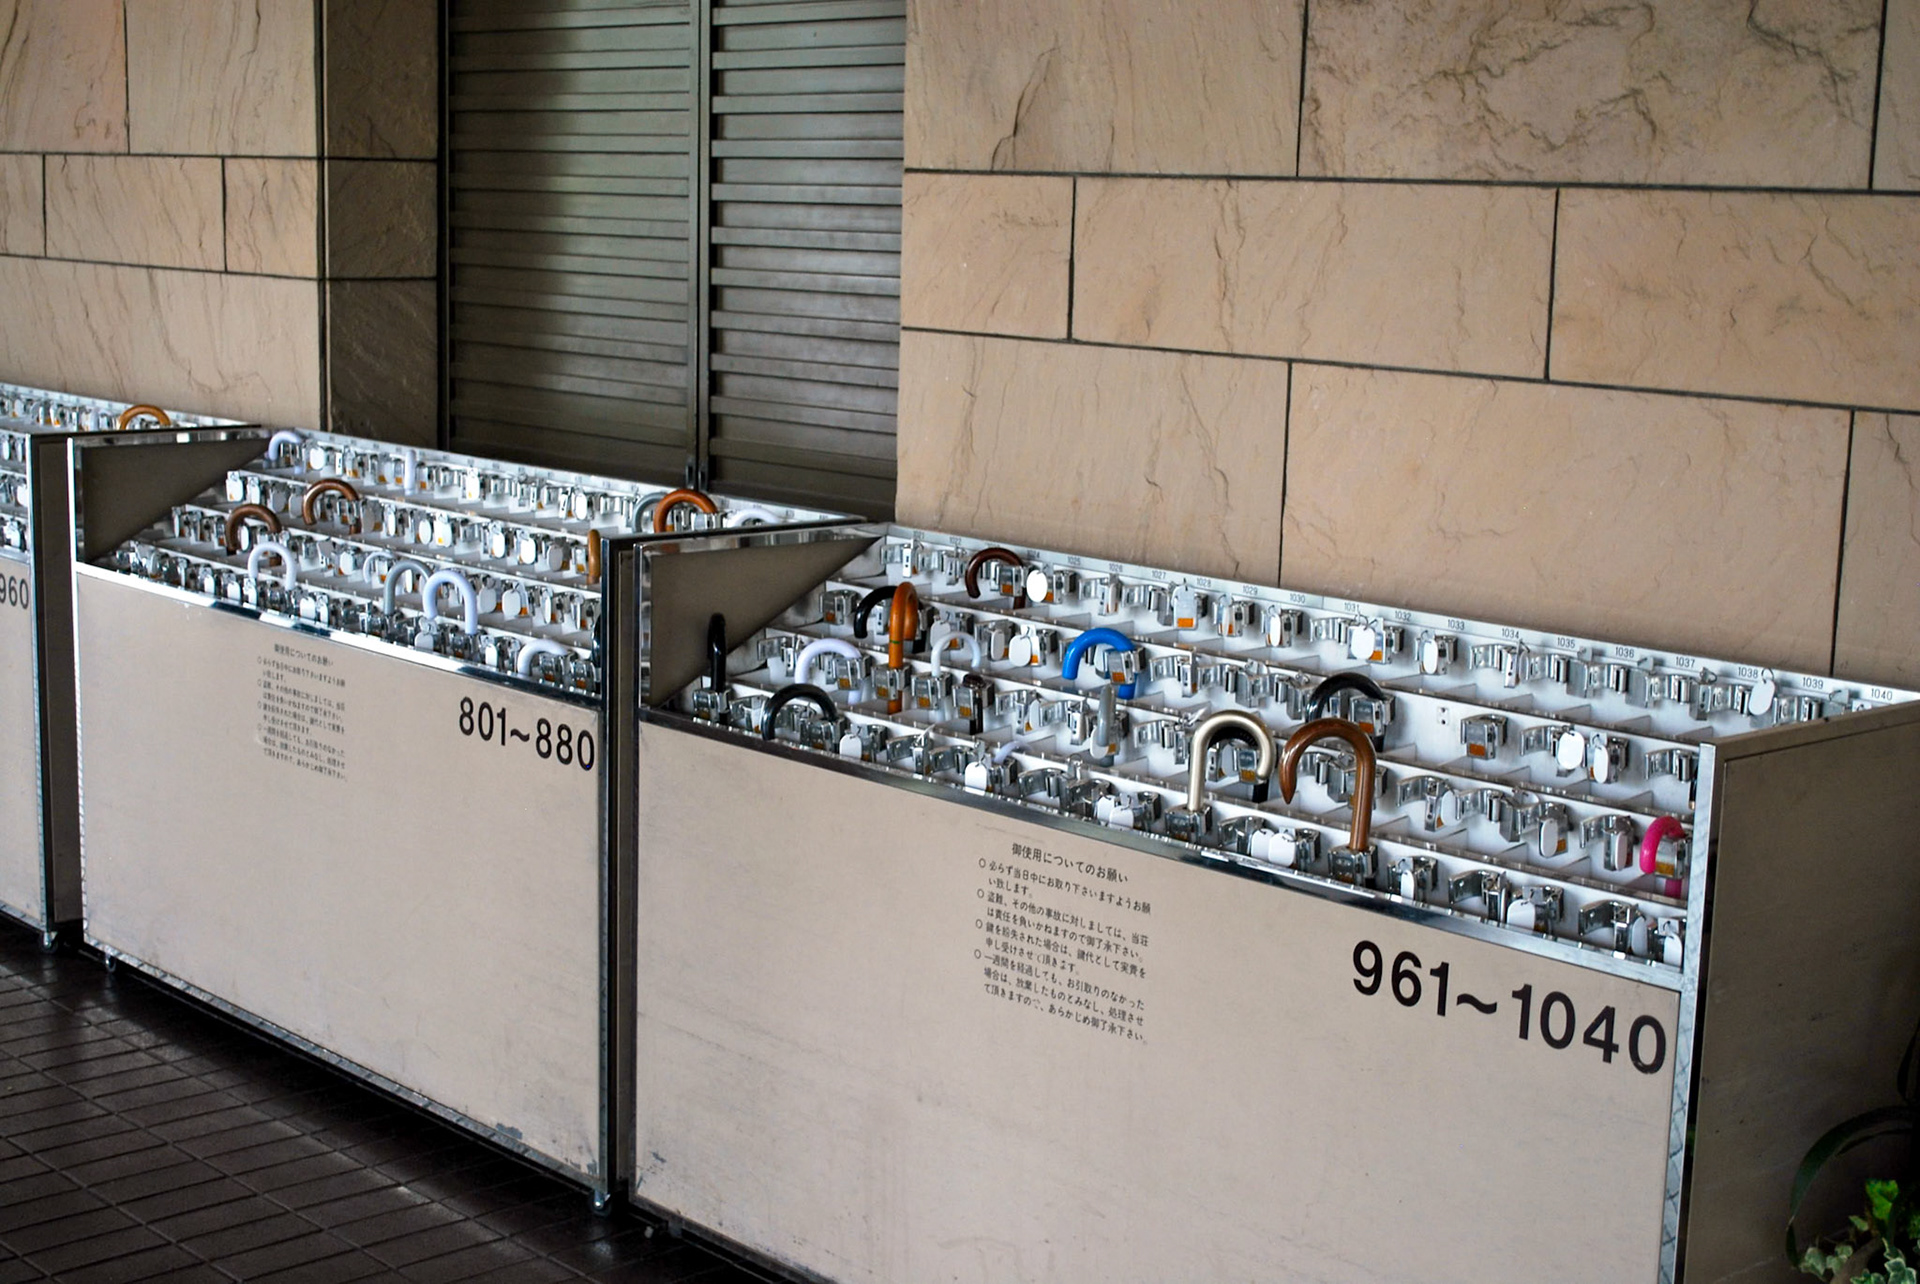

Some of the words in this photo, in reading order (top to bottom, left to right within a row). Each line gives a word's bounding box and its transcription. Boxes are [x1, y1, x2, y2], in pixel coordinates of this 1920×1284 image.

[1152, 569, 1167, 579] 1027
[1243, 585, 1258, 595] 1029
[1290, 593, 1306, 603] 1030
[1344, 602, 1360, 612] 1031
[1395, 611, 1411, 621] 1032
[1448, 620, 1465, 630] 1033
[1502, 628, 1520, 639] 1034
[1557, 637, 1575, 648] 1035
[1615, 647, 1635, 658] 1036
[1675, 656, 1695, 668] 1037
[1738, 667, 1759, 679] 1038
[1802, 677, 1824, 690] 1039
[1871, 689, 1893, 702] 1040
[459, 695, 594, 771] 801~880
[1012, 843, 1128, 883] 御使用についてのお願い
[988, 877, 1033, 899] い致します。
[1353, 940, 1667, 1075] 961~1040
